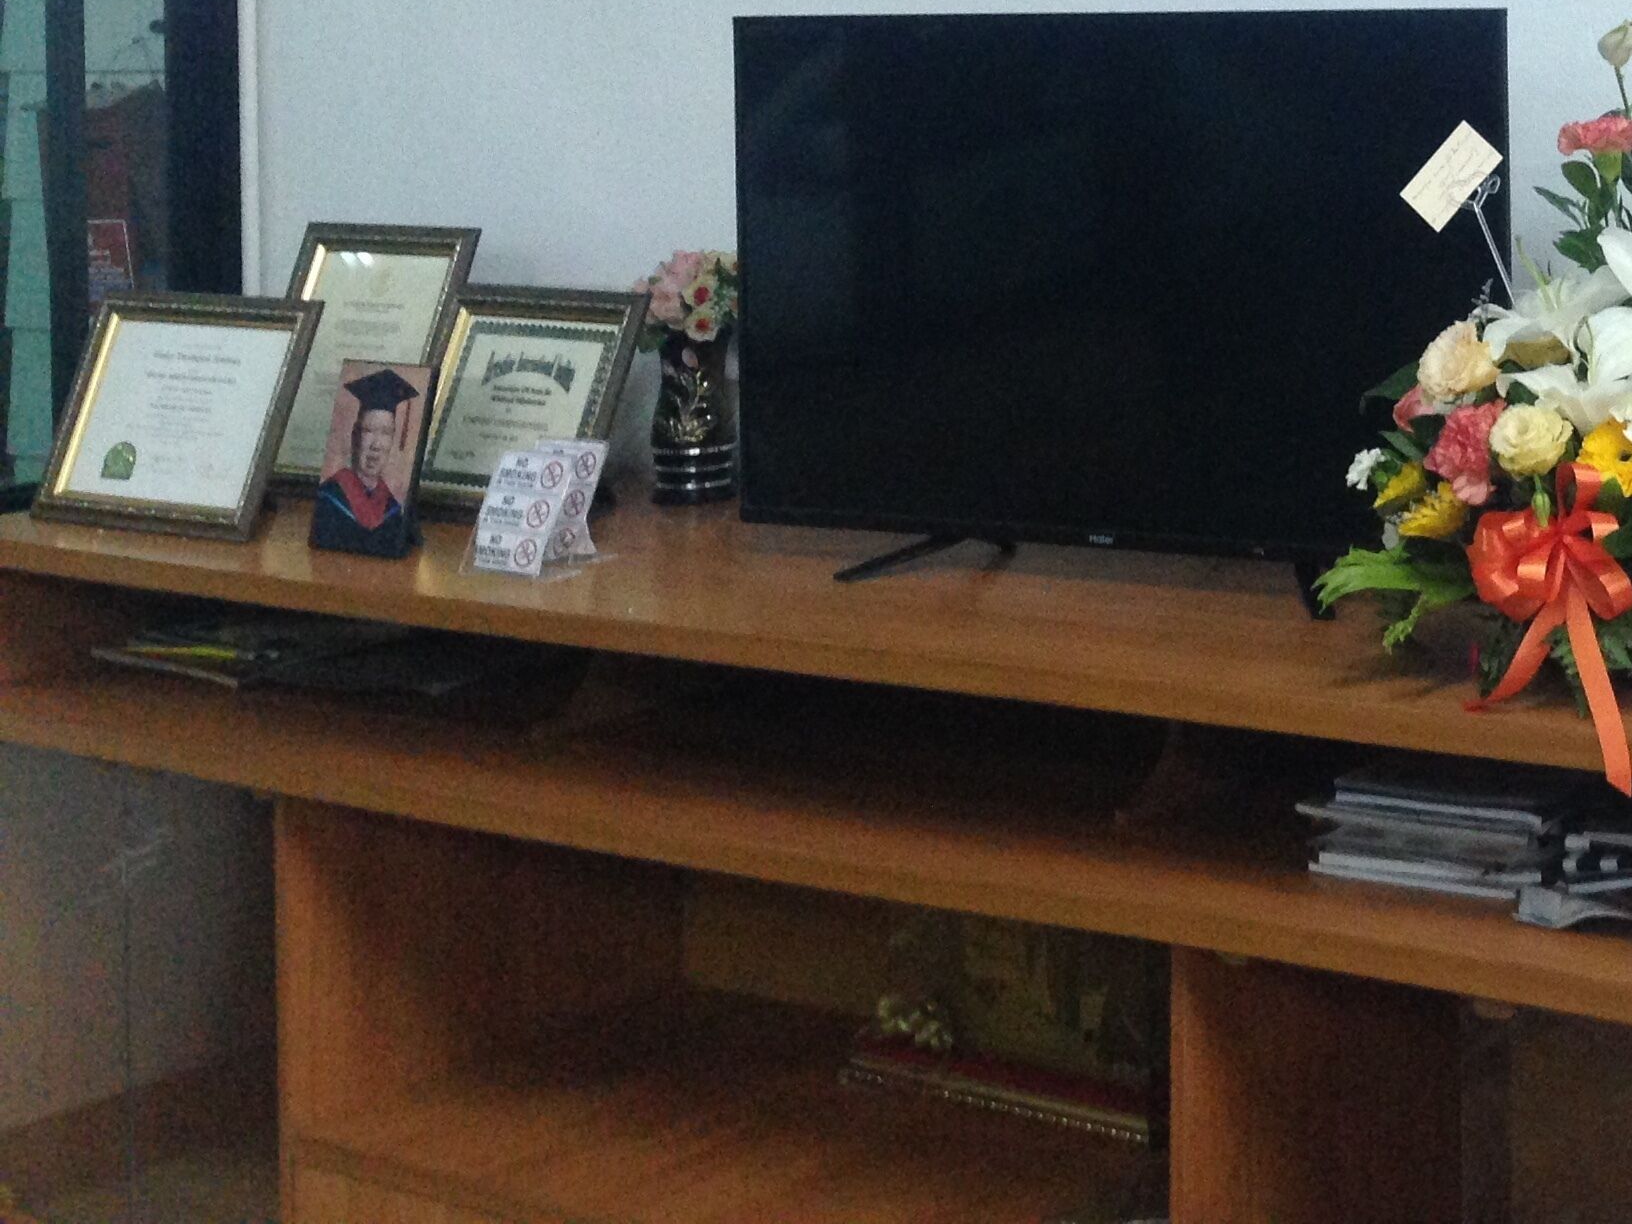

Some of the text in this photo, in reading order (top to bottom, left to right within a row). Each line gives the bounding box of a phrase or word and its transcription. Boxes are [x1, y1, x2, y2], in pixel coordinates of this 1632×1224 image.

[516, 456, 529, 467] NO
[500, 467, 537, 482] SMOKING
[502, 495, 515, 505] NO
[484, 505, 523, 520] SMOKING
[489, 534, 503, 545] NO
